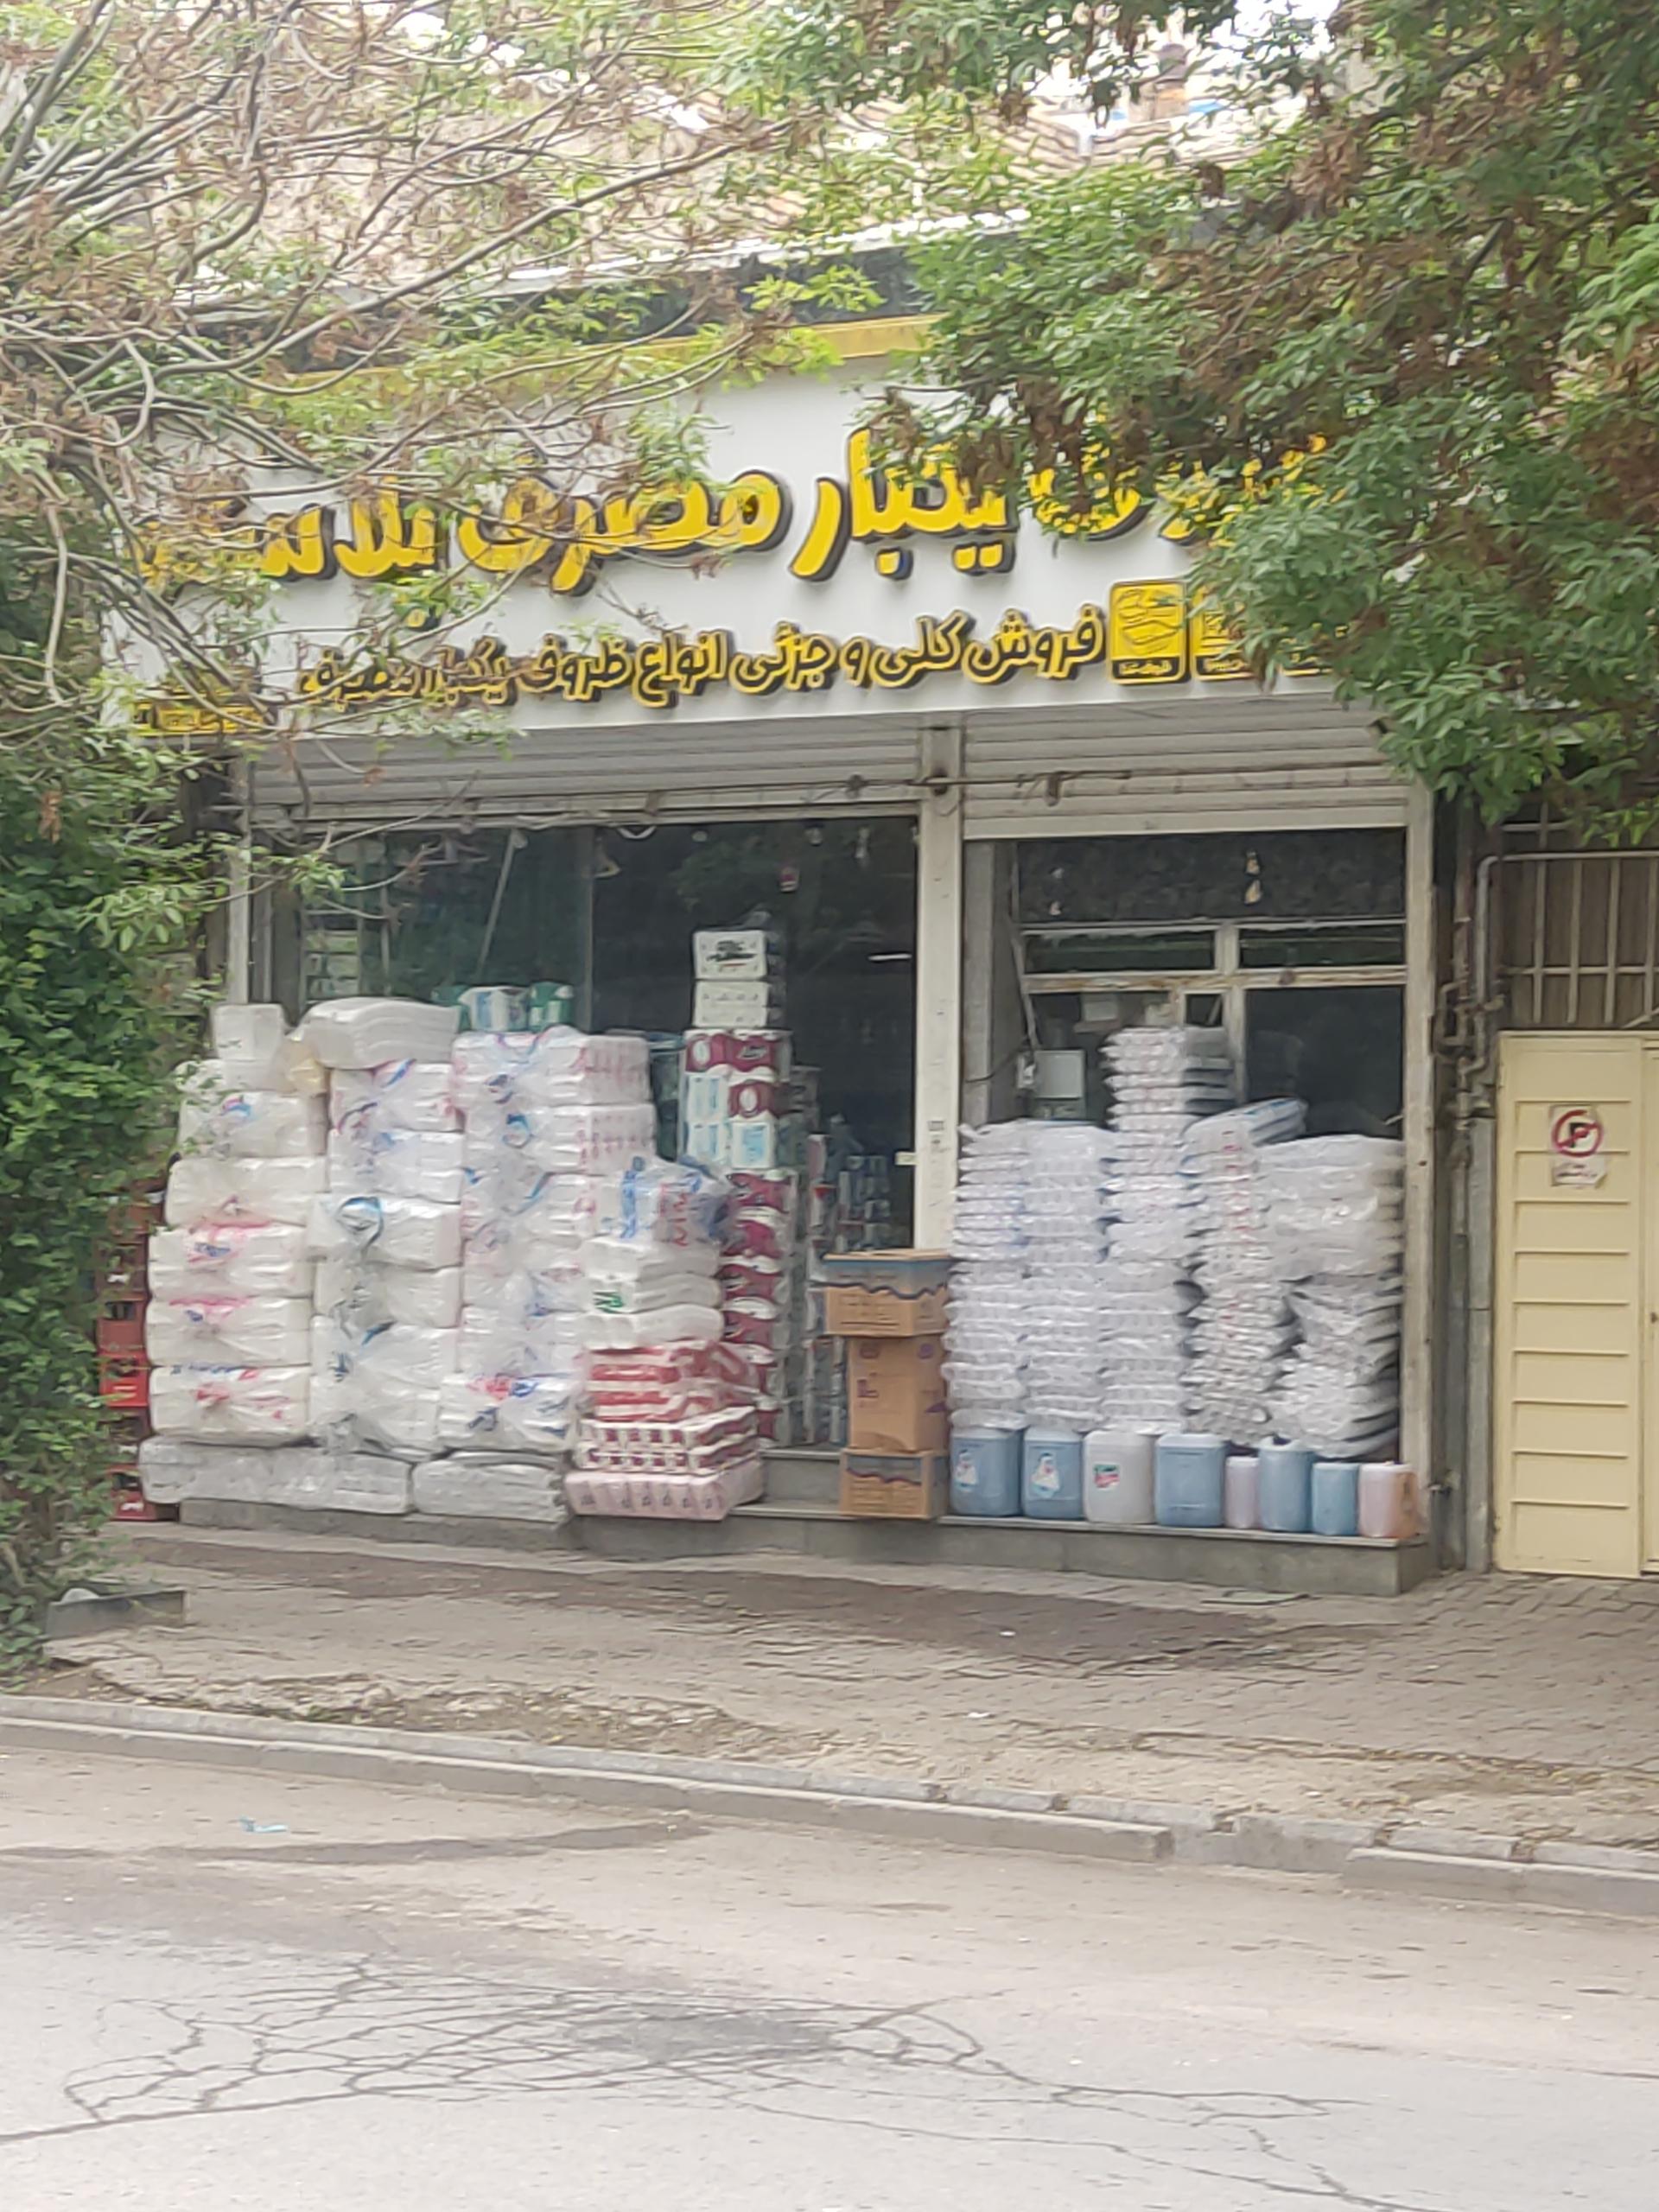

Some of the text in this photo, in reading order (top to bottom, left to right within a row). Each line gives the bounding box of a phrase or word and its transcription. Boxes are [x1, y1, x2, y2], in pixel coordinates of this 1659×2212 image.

[518, 633, 633, 702] ظروف
[632, 628, 730, 709] انواع
[730, 620, 835, 694] جزئی
[839, 635, 869, 686] و
[868, 608, 964, 688] کلی
[961, 602, 1107, 684] فروش
